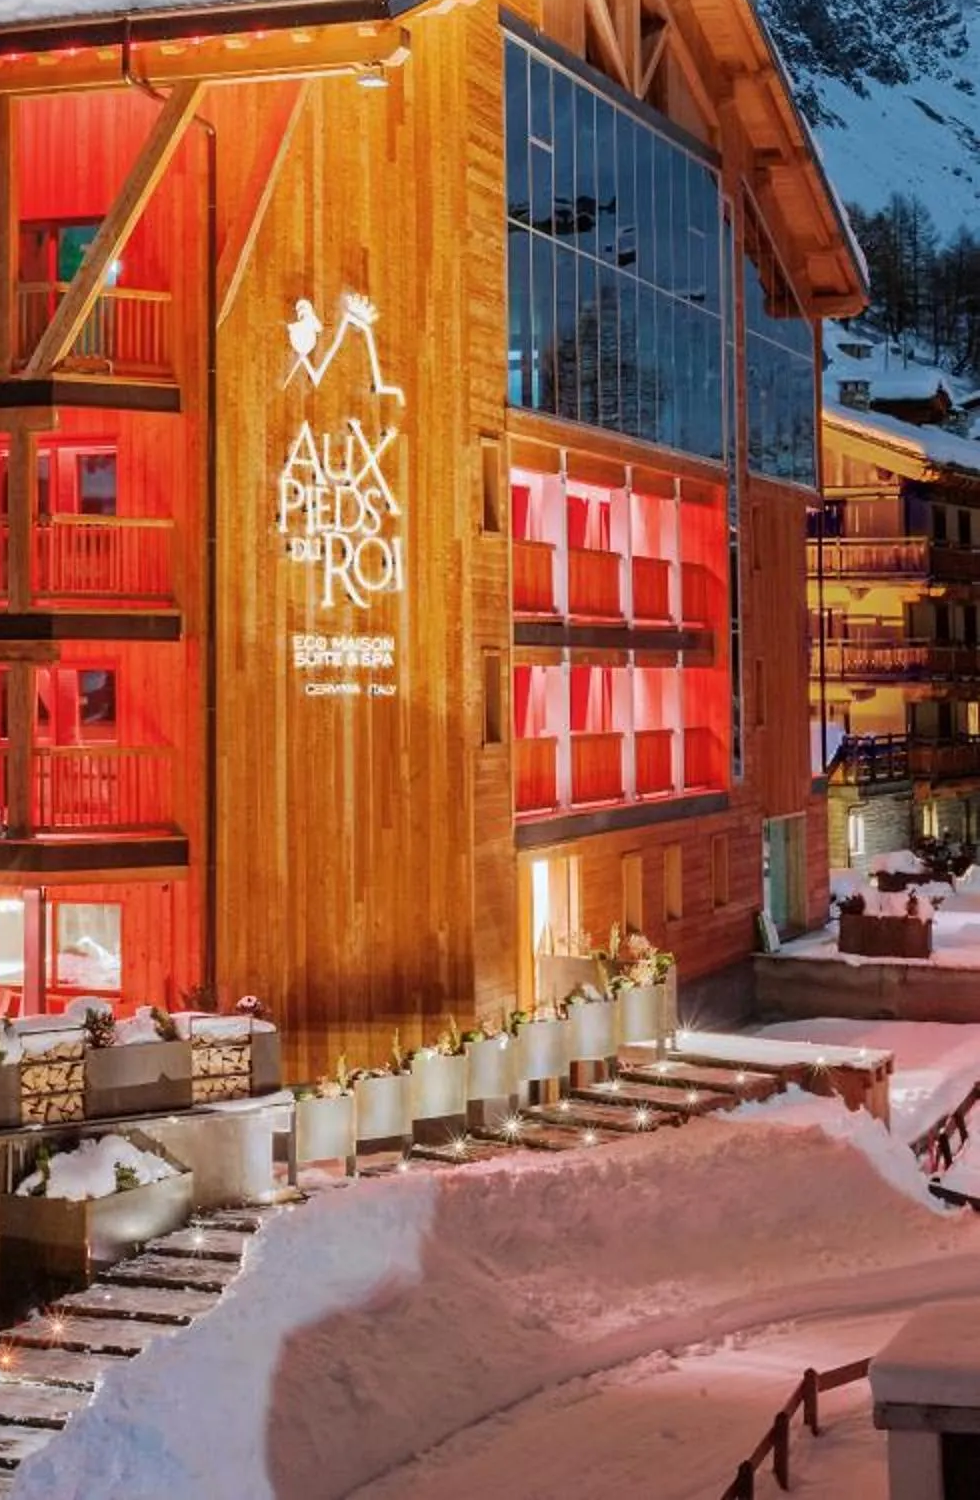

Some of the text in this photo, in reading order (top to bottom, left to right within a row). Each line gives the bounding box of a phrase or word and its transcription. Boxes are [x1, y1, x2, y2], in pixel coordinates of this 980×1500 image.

[283, 418, 401, 516] AUX
[279, 476, 382, 534] PIEDS
[290, 534, 404, 609] DU ROI
[293, 635, 395, 652] ECO MAISON
[361, 652, 394, 668] SPA
